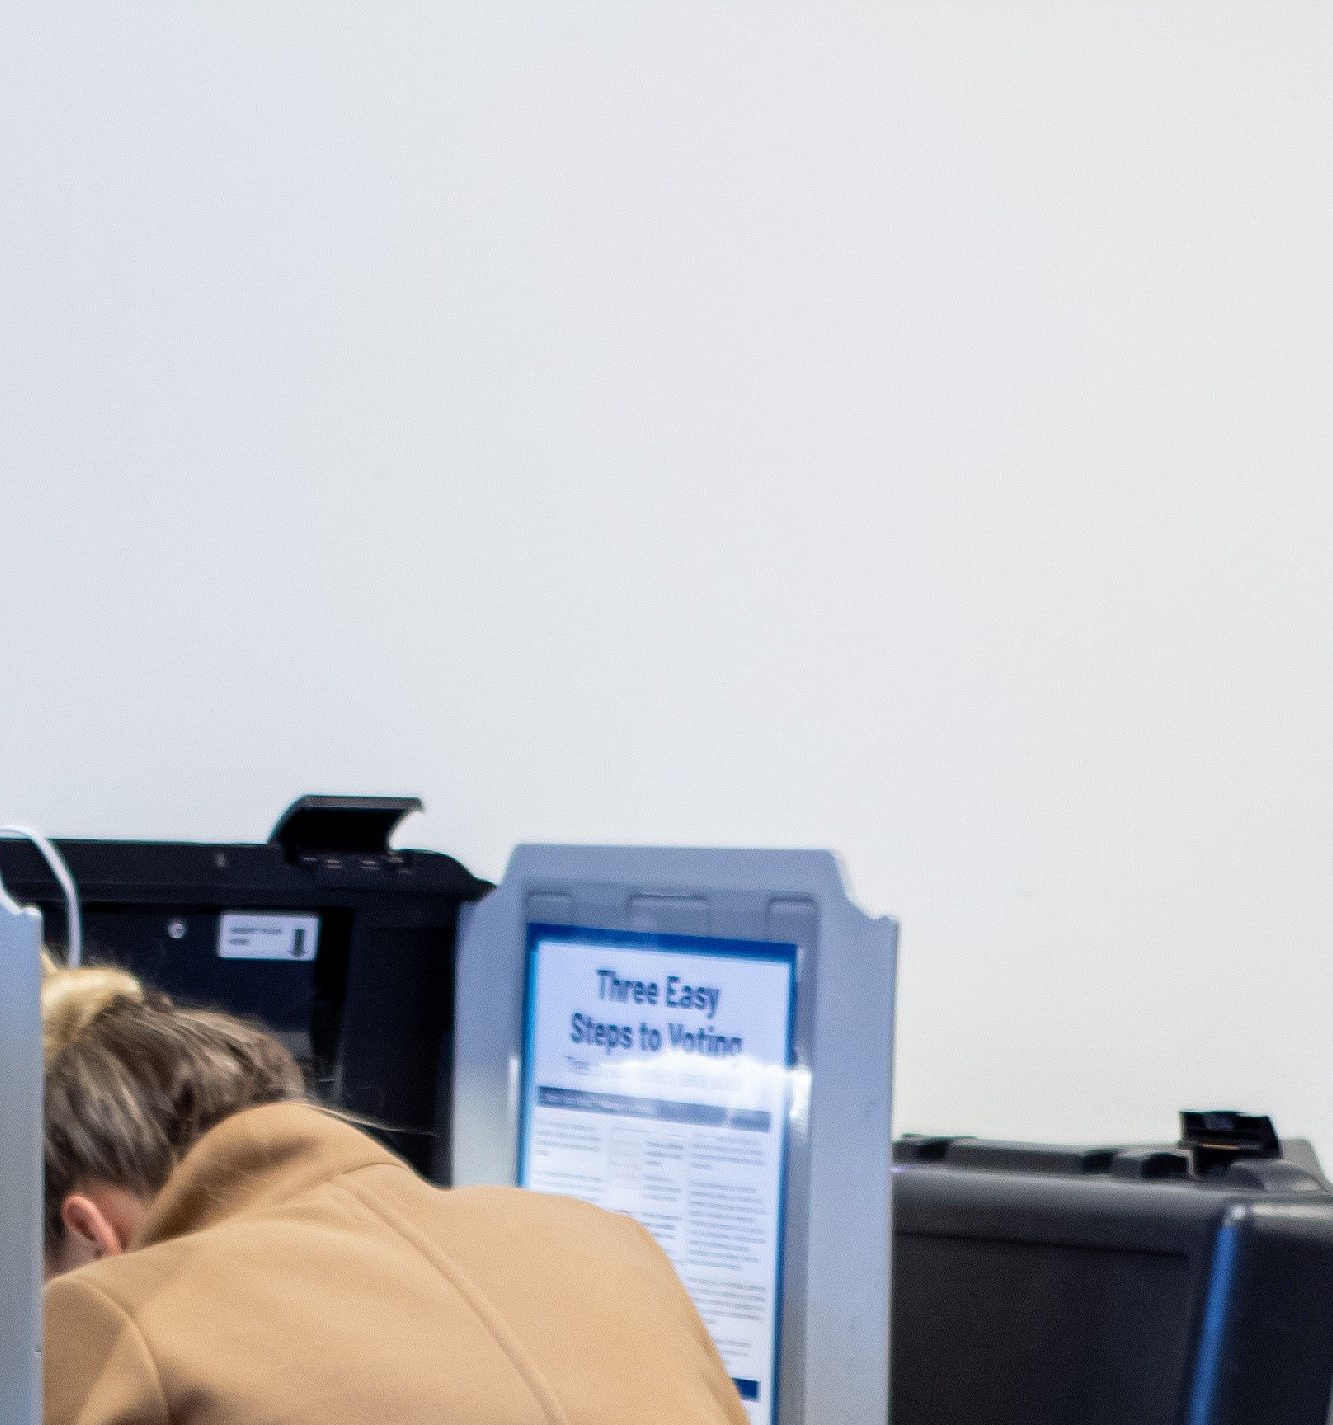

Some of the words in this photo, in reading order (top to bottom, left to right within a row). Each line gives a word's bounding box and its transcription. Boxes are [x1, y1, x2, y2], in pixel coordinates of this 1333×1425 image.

[596, 968, 658, 1005] Three
[666, 975, 721, 1020] Easy
[570, 1012, 634, 1056] Steps
[639, 1022, 662, 1051] to
